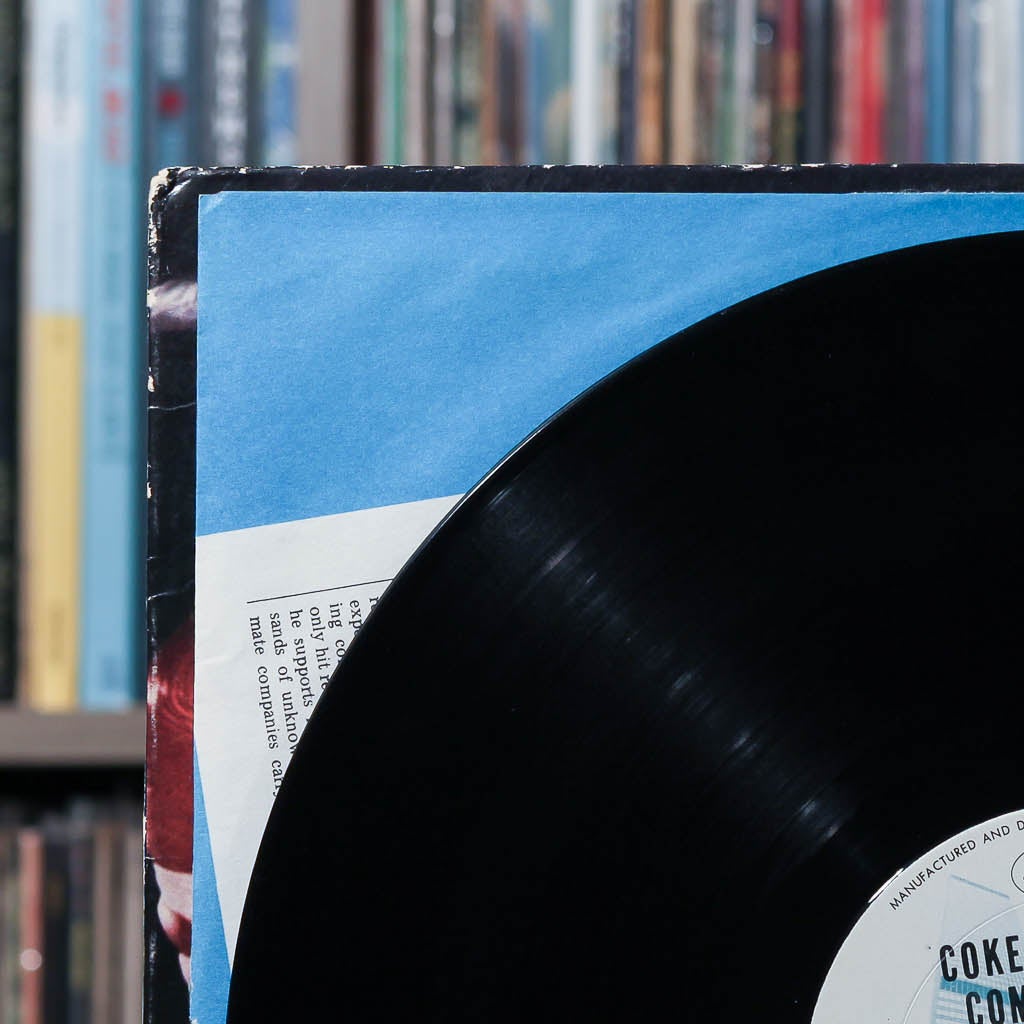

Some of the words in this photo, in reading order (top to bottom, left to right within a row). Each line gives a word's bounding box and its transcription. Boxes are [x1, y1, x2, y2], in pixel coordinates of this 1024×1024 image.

[290, 610, 303, 628] he
[310, 606, 326, 642] only
[328, 603, 343, 629] ing
[270, 613, 288, 656] sands
[335, 639, 346, 662] co
[278, 666, 293, 682] of
[293, 638, 313, 707] supports
[316, 647, 330, 670] hit
[249, 615, 264, 656] mate
[257, 666, 279, 749] companies
[889, 839, 976, 911] MANUFACTURED
[982, 825, 1011, 845] AND
[939, 935, 1024, 983] COKE
